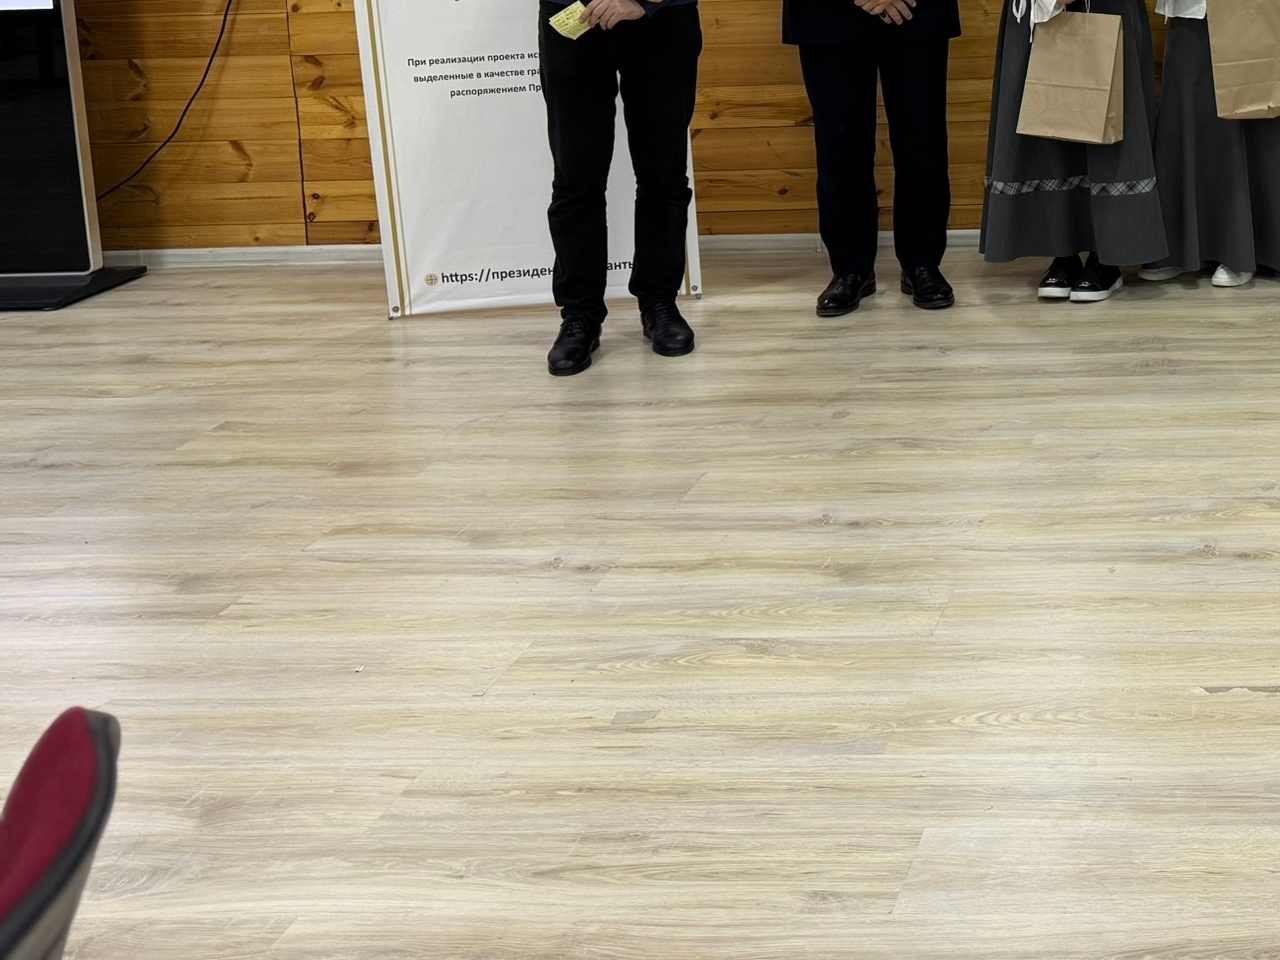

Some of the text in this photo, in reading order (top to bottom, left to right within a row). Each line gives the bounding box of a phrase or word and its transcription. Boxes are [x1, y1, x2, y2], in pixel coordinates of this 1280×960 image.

[407, 58, 427, 68] При
[428, 55, 485, 67] реализации
[487, 52, 525, 63] проекта
[413, 71, 474, 83] выделенные
[484, 68, 525, 78] качестве
[450, 84, 526, 98] распоряжением
